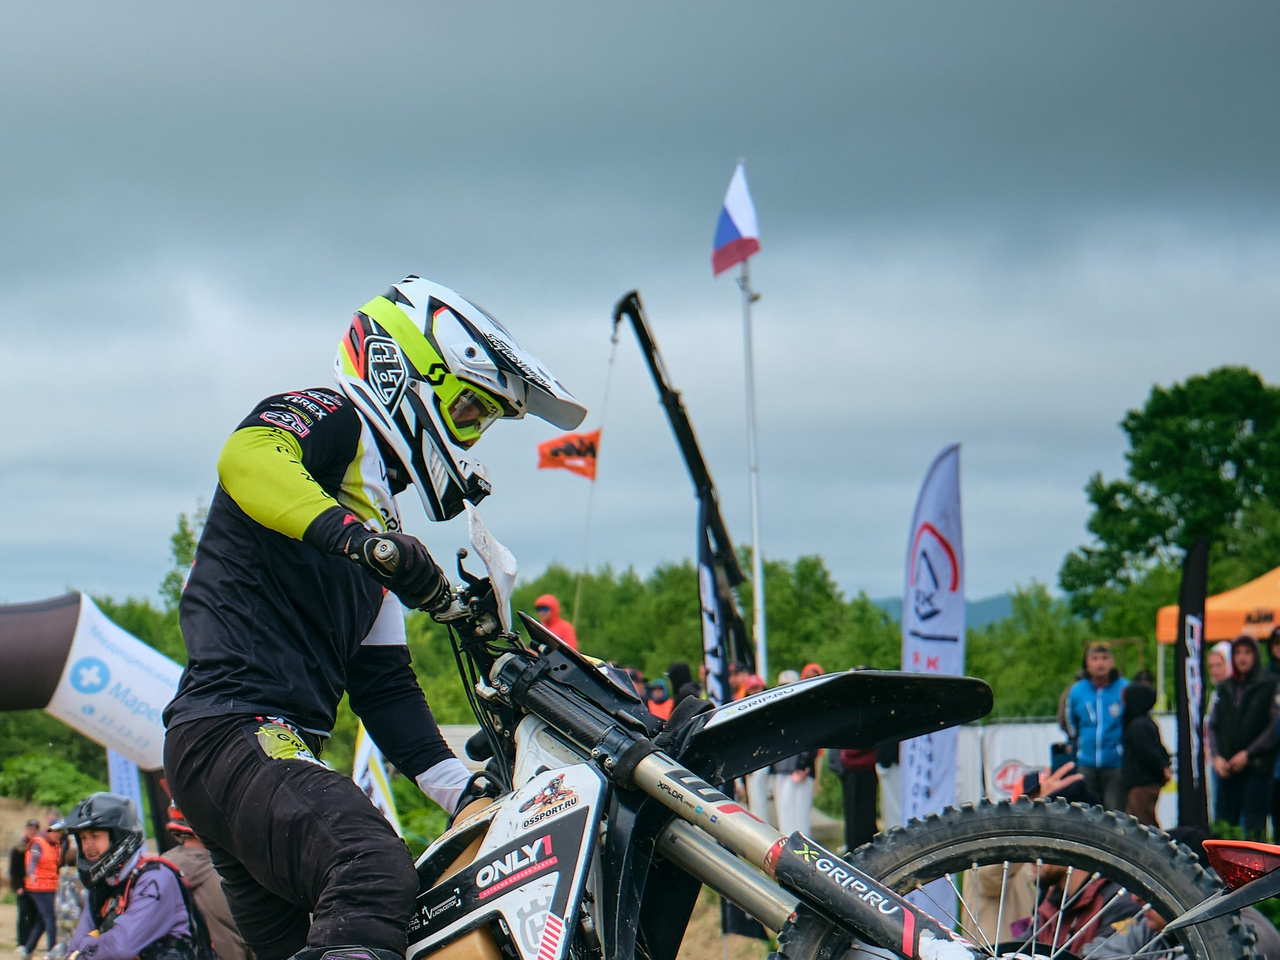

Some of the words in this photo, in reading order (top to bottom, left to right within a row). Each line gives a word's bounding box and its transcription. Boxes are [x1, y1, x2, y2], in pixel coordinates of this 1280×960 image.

[657, 780, 684, 802] XPLOR
[522, 797, 578, 829] OSSPORT.RU
[476, 834, 553, 889] ONLY1
